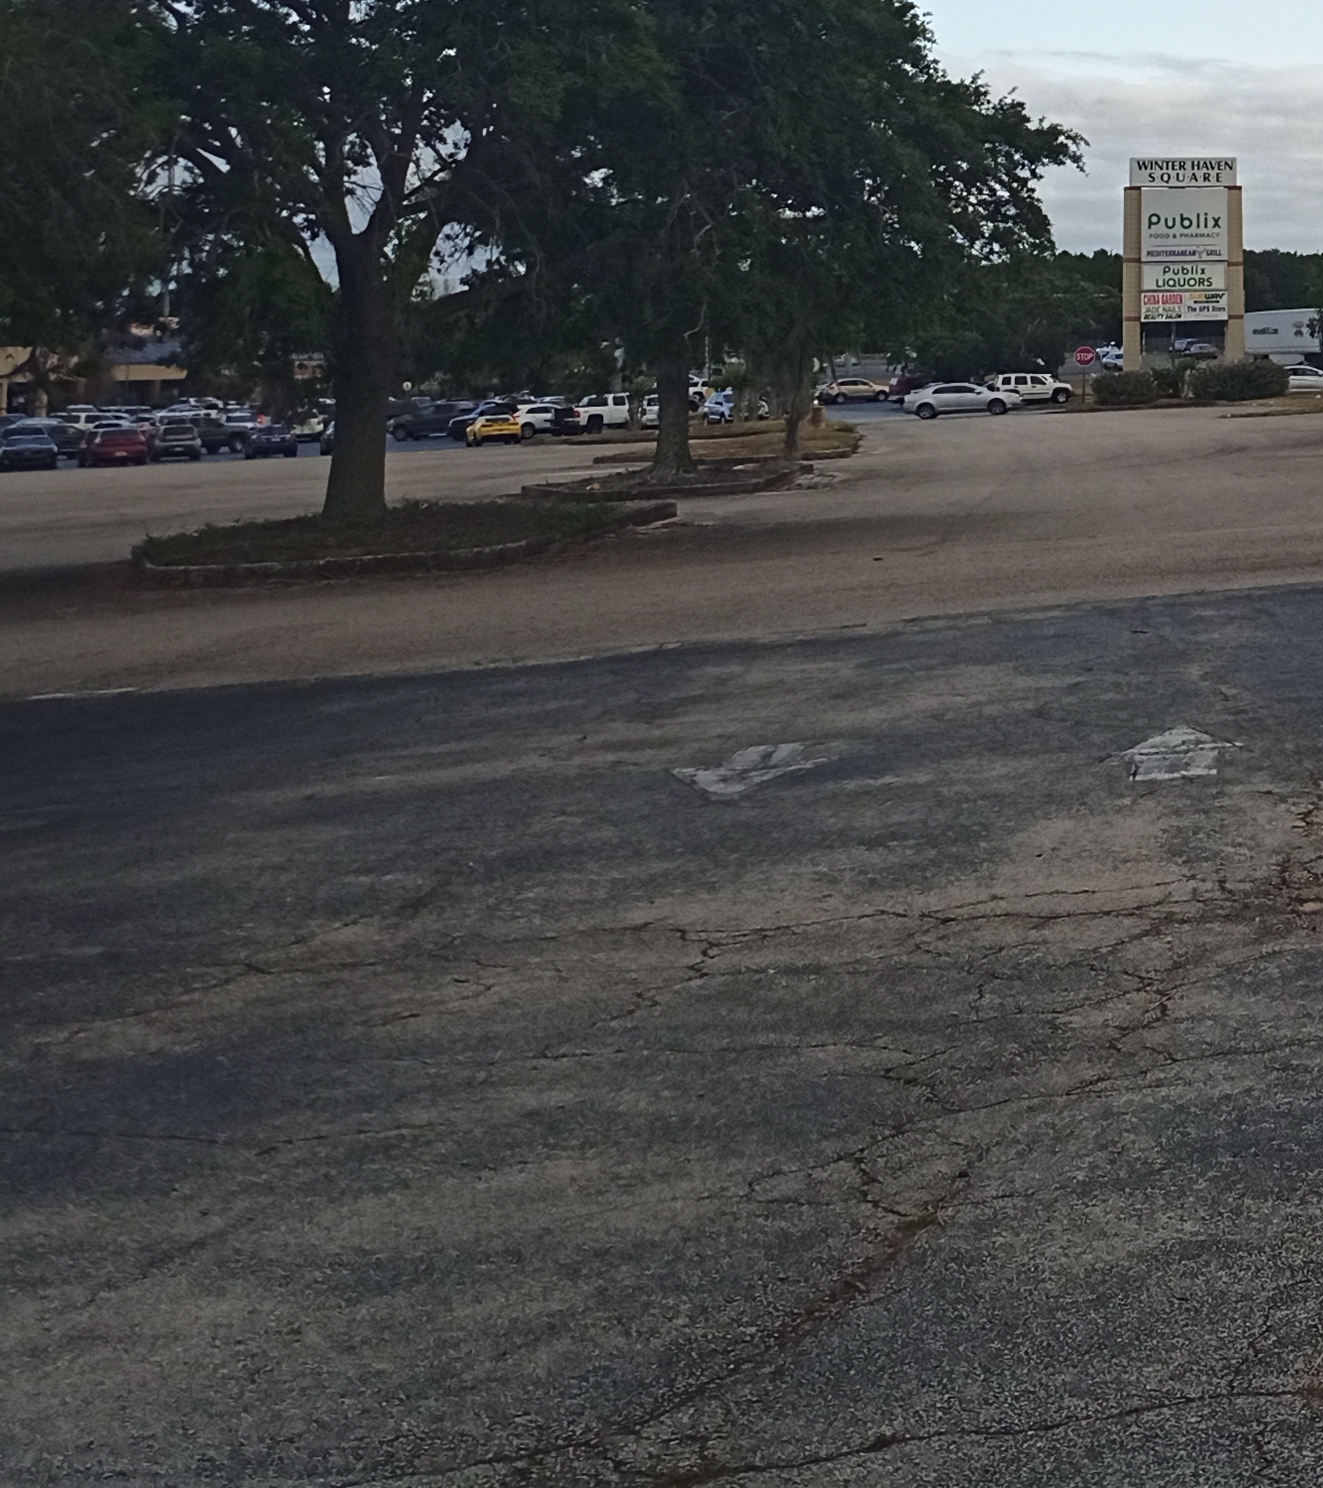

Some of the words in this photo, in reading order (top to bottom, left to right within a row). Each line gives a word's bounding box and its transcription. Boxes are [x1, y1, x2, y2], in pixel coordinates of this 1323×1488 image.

[1137, 160, 1186, 171] WINTER
[1191, 160, 1234, 171] HAVEN
[1148, 212, 1221, 229] Publix
[1163, 264, 1206, 275] Publix
[1156, 277, 1213, 288] LIQUORS
[1144, 294, 1160, 305] CHINA
[1161, 293, 1183, 304] GARDEN
[1076, 352, 1094, 360] STOP
